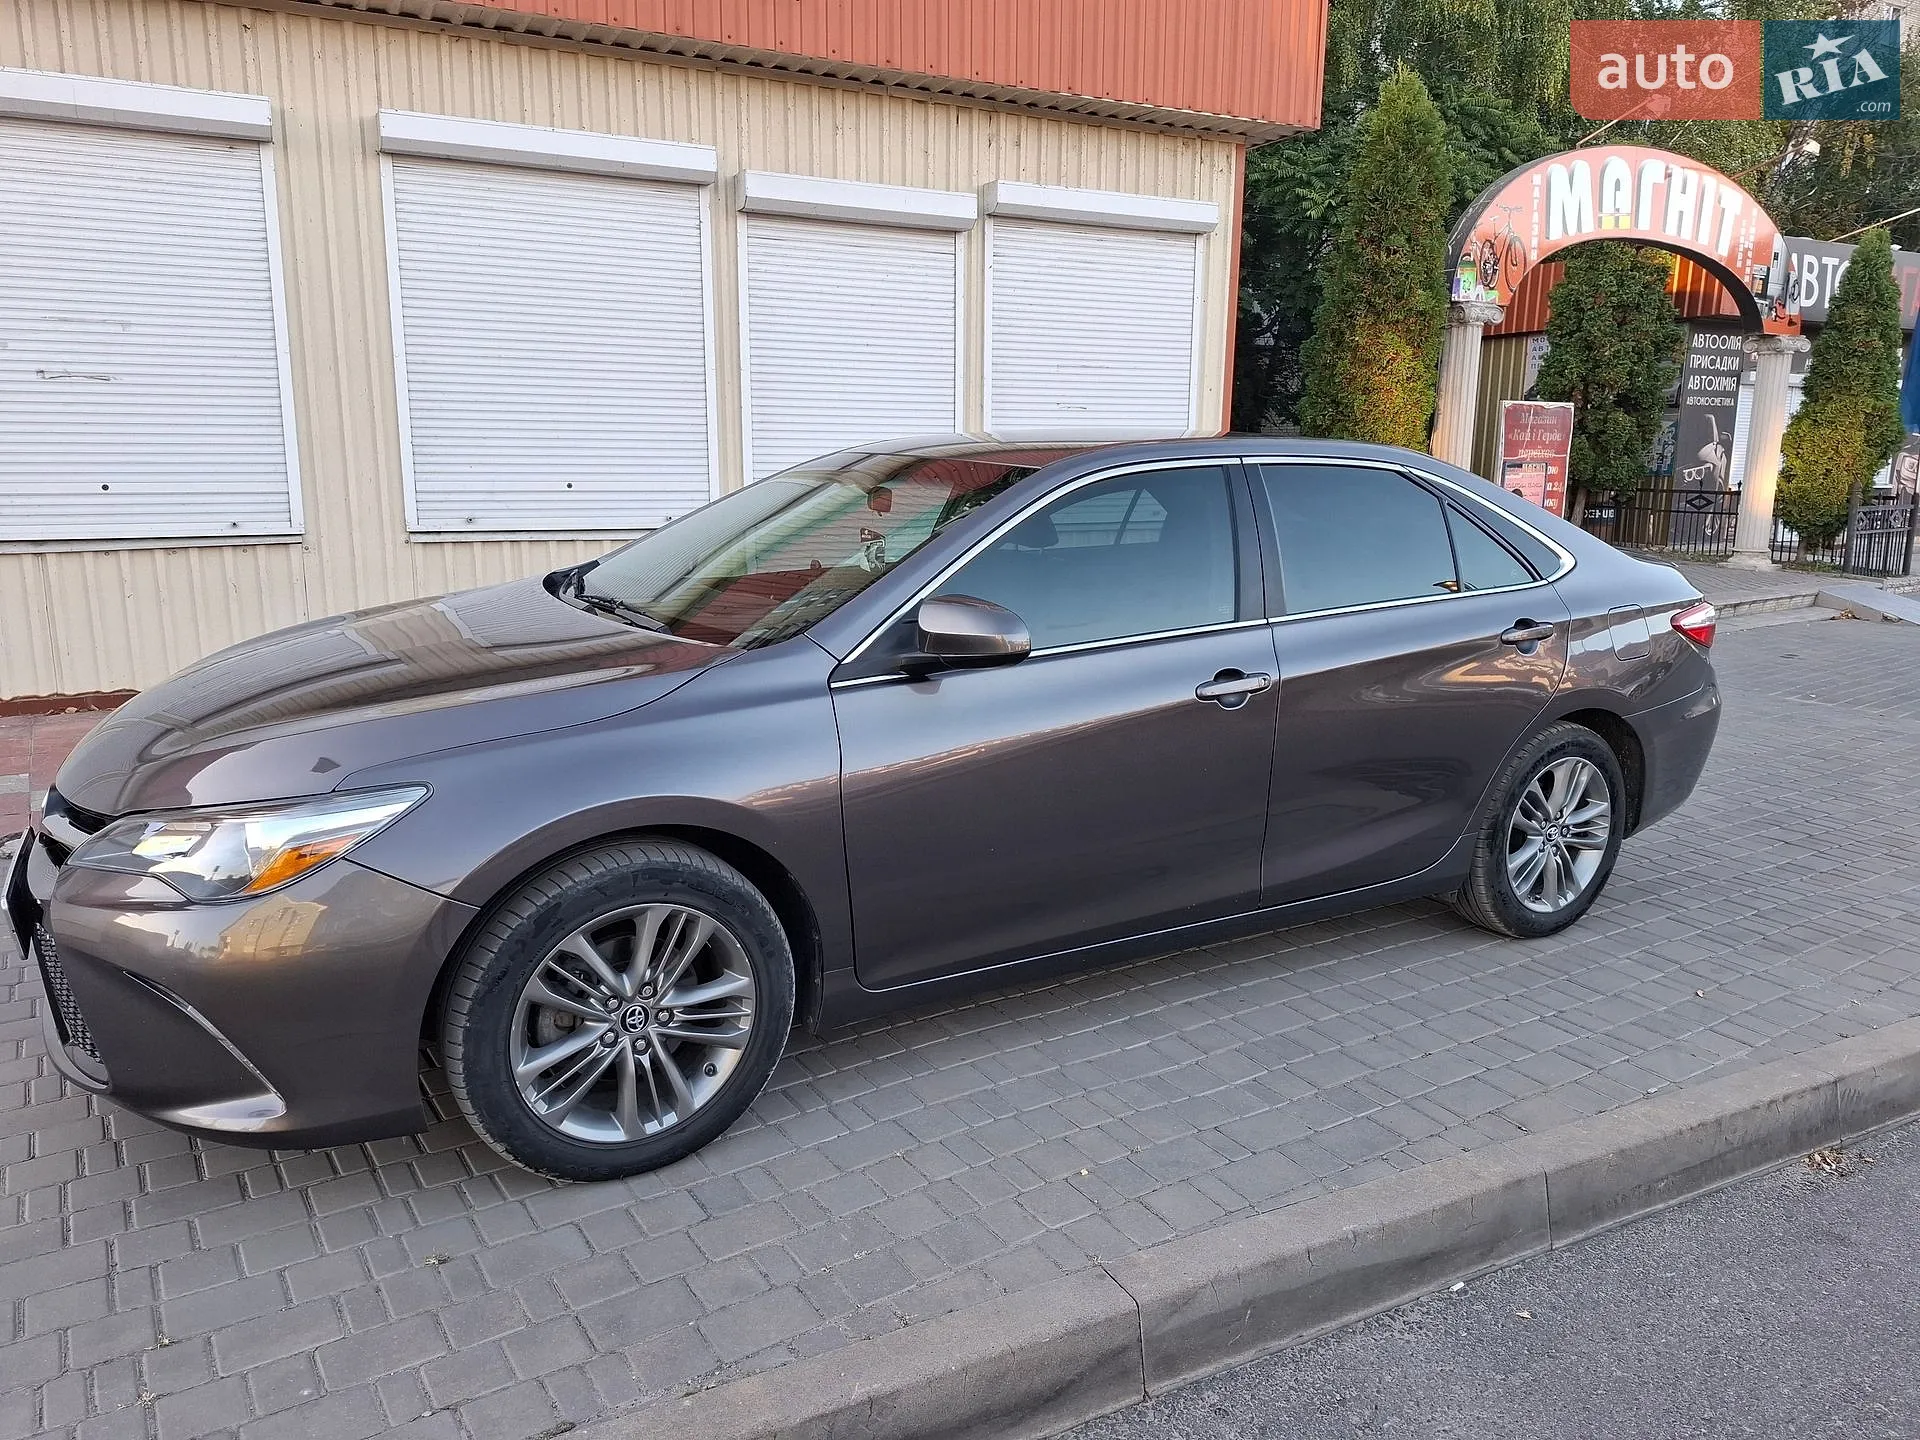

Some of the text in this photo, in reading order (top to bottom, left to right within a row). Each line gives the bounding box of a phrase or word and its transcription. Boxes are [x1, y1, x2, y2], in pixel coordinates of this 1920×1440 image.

[1545, 155, 1744, 258] МАГНІТ
[1692, 333, 1742, 350] АВТООЛІЯ
[1689, 354, 1740, 371] ПРИСАДКИ
[1687, 375, 1737, 391] АВТОХІМІЯ
